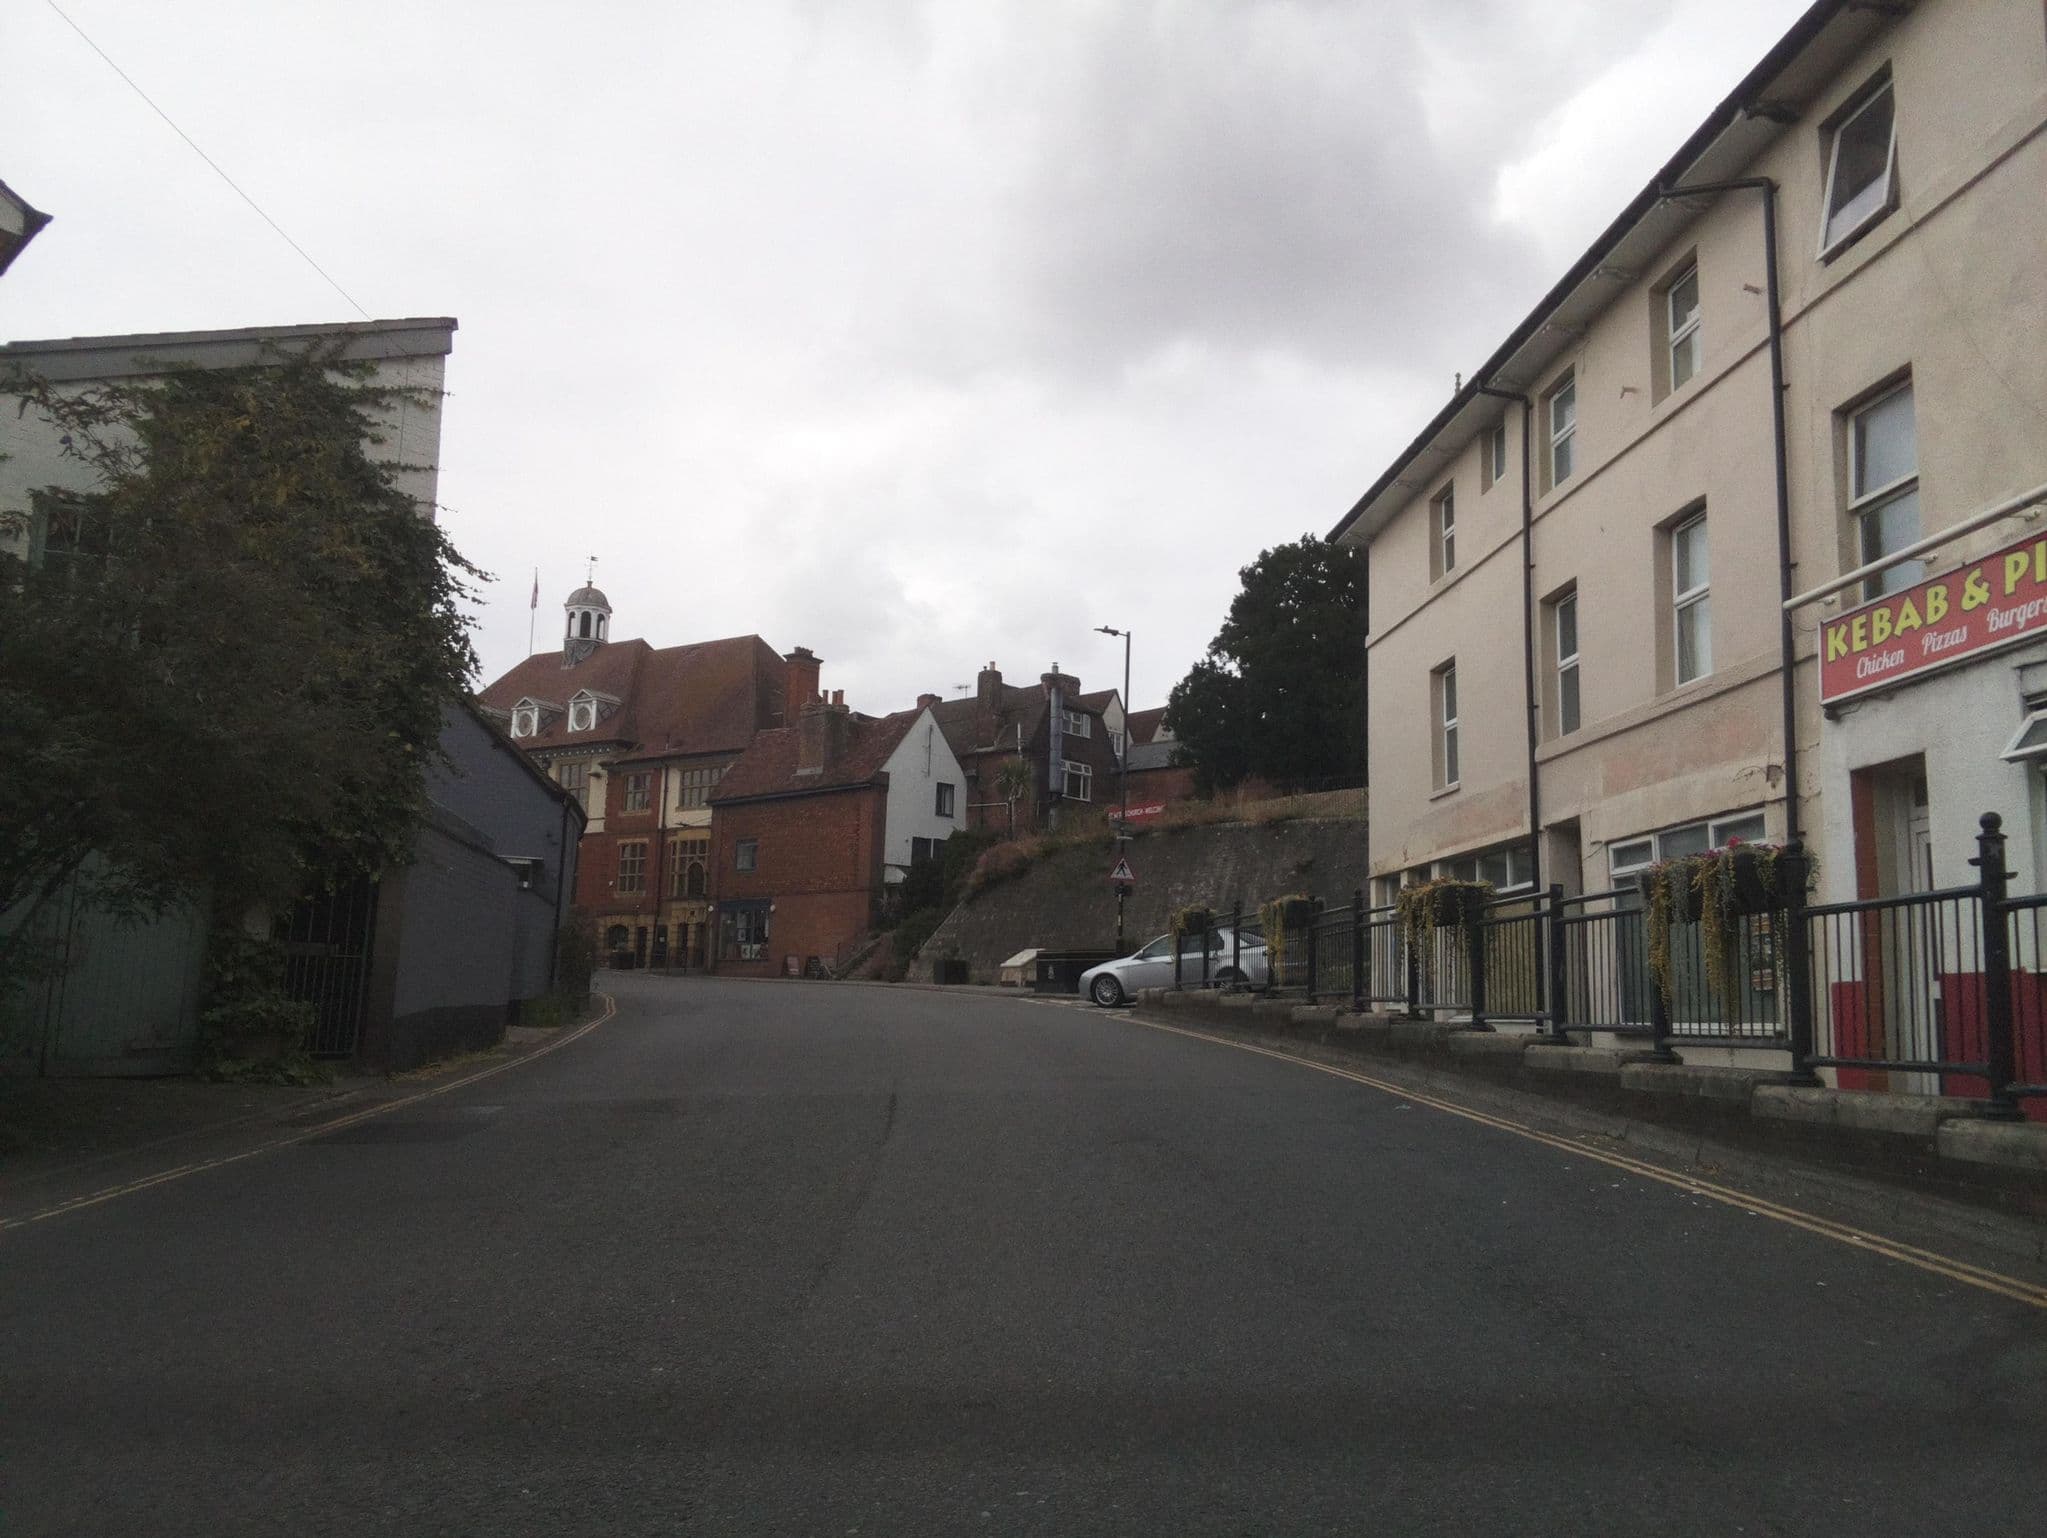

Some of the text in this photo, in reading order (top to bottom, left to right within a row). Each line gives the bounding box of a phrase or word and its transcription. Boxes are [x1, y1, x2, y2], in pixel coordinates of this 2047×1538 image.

[1827, 585, 1949, 662] KEBAB
[1961, 568, 1990, 611] &
[1856, 649, 1905, 678] Chicken
[1922, 626, 1967, 655] Pizzas
